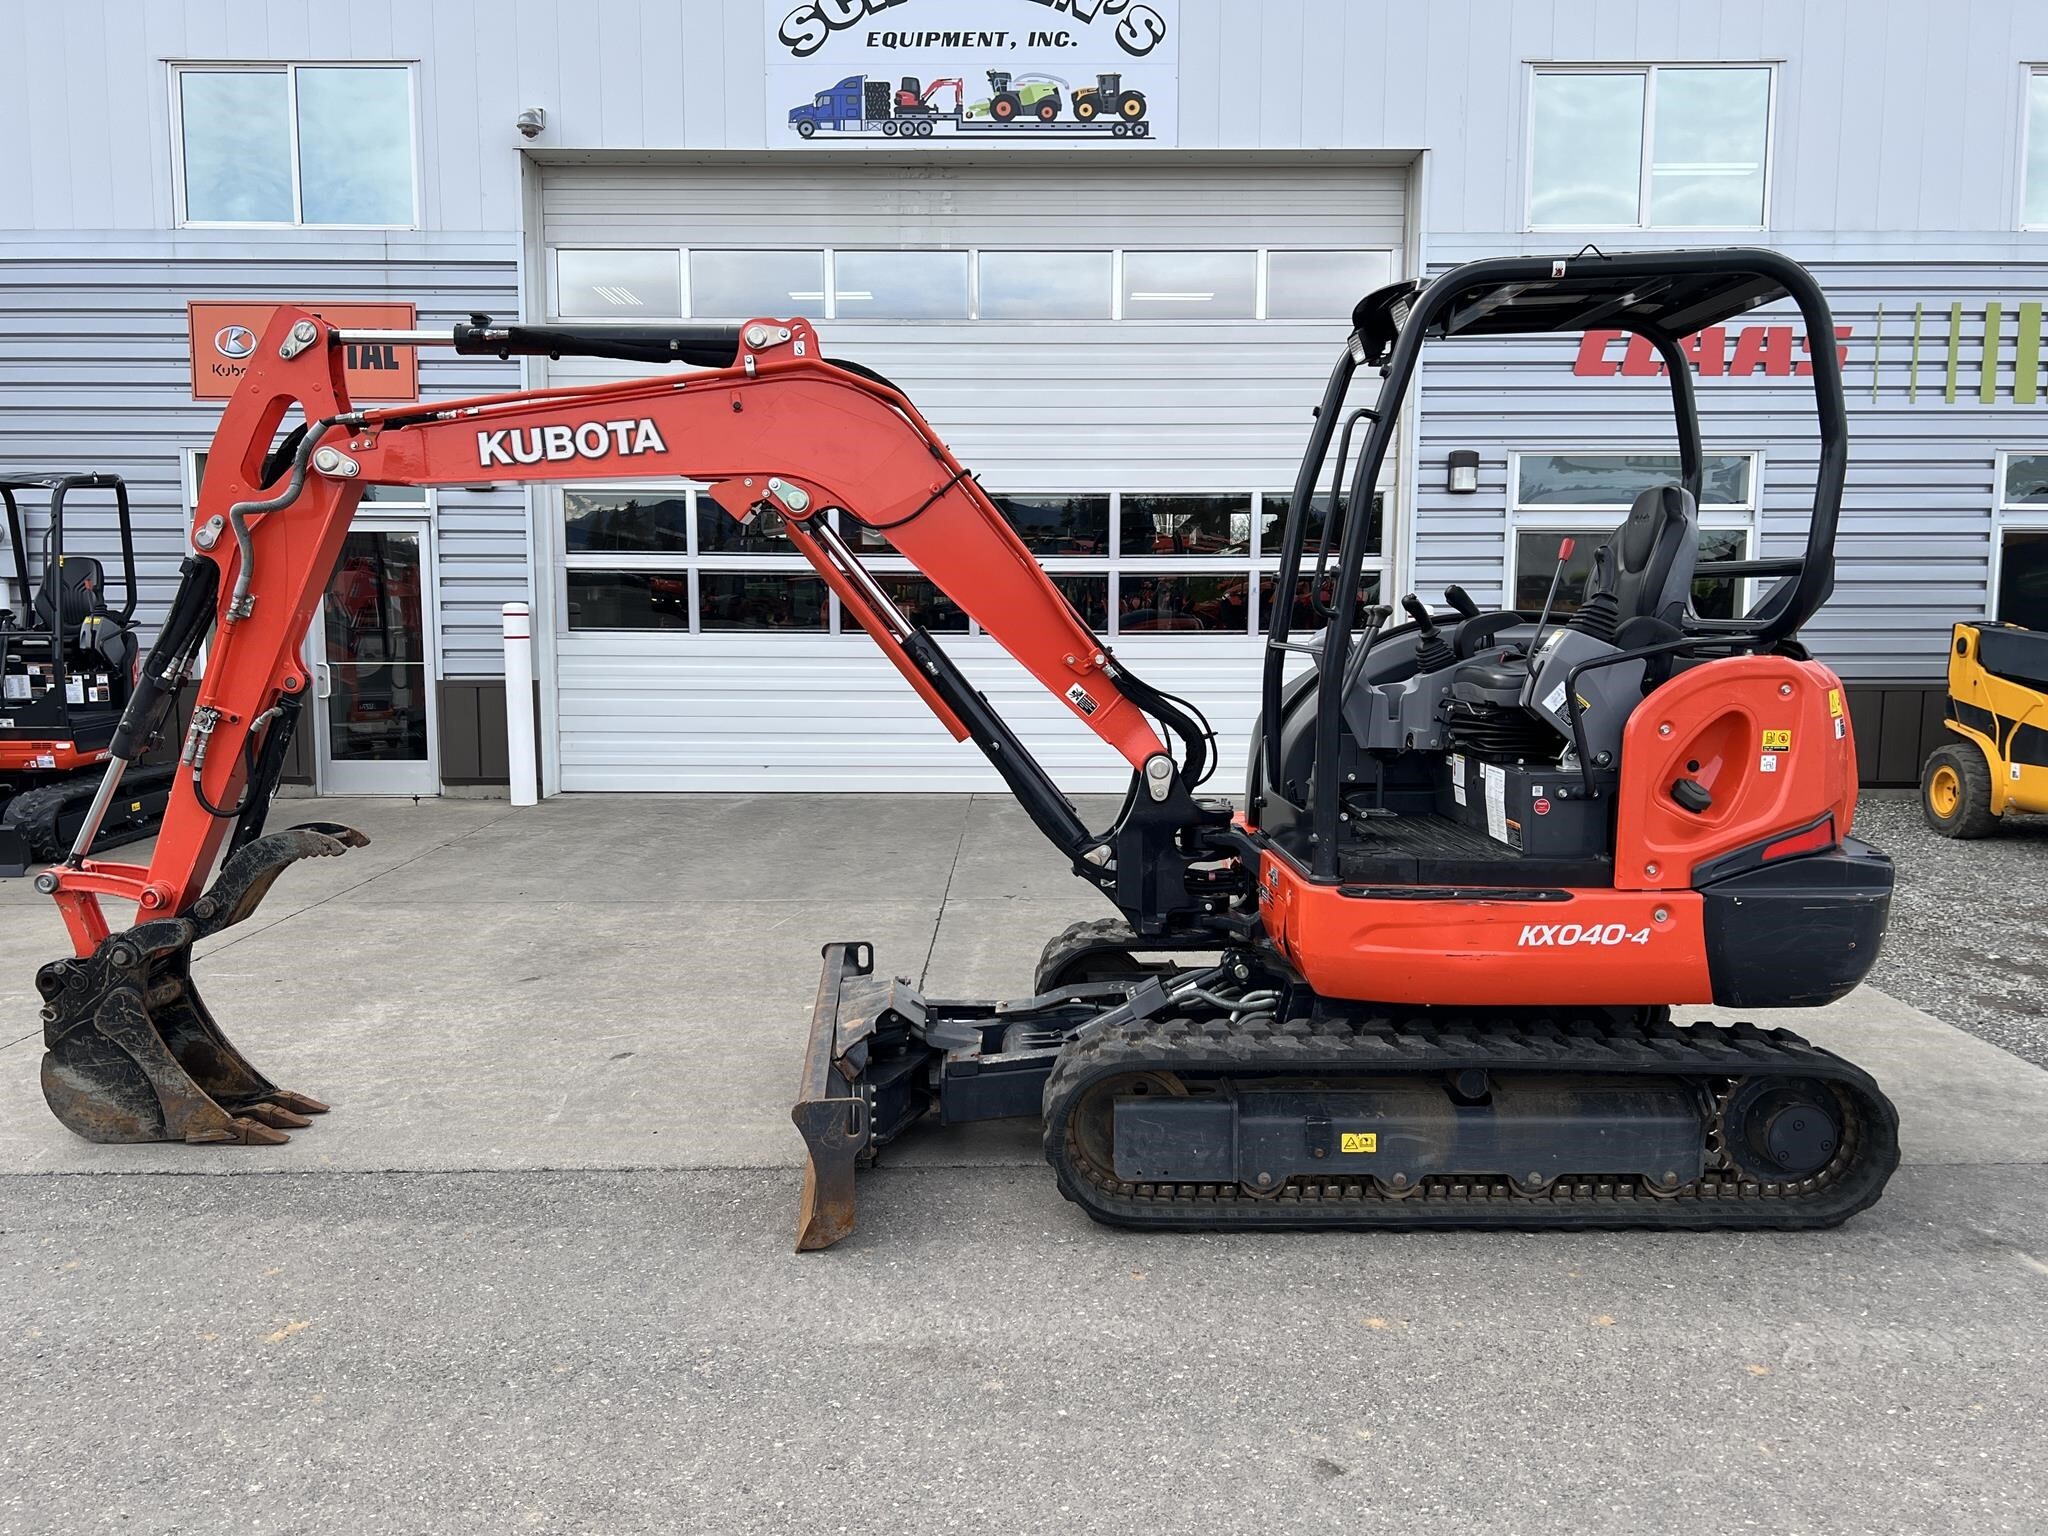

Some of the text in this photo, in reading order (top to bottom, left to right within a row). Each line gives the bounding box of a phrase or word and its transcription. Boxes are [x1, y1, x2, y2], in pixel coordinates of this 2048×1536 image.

[866, 31, 1078, 50] EQUIPMENT, INC.
[212, 363, 247, 377] Kub
[477, 418, 668, 468] KUBOTA
[1517, 923, 1650, 947] KX040-4
